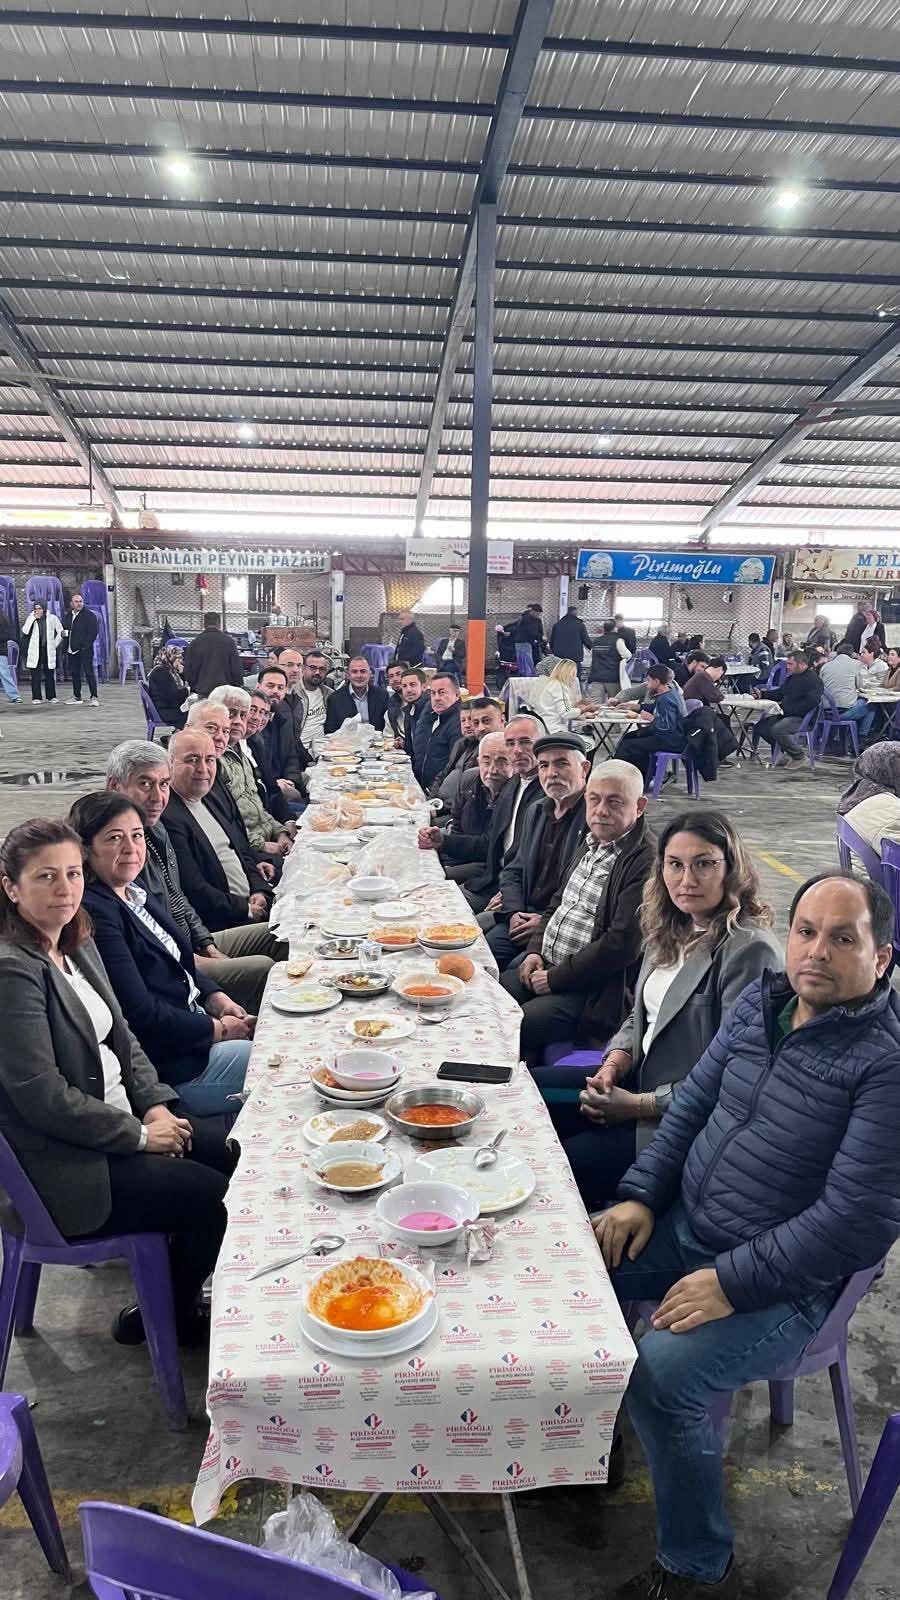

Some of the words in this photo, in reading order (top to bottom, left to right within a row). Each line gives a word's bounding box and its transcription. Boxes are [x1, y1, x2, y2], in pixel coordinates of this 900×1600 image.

[118, 551, 202, 565] ORHANLAR
[208, 553, 265, 567] PEYNİR
[271, 555, 326, 568] PAZARI
[632, 553, 722, 579] Pirimoğlu
[840, 568, 870, 579] SÜT
